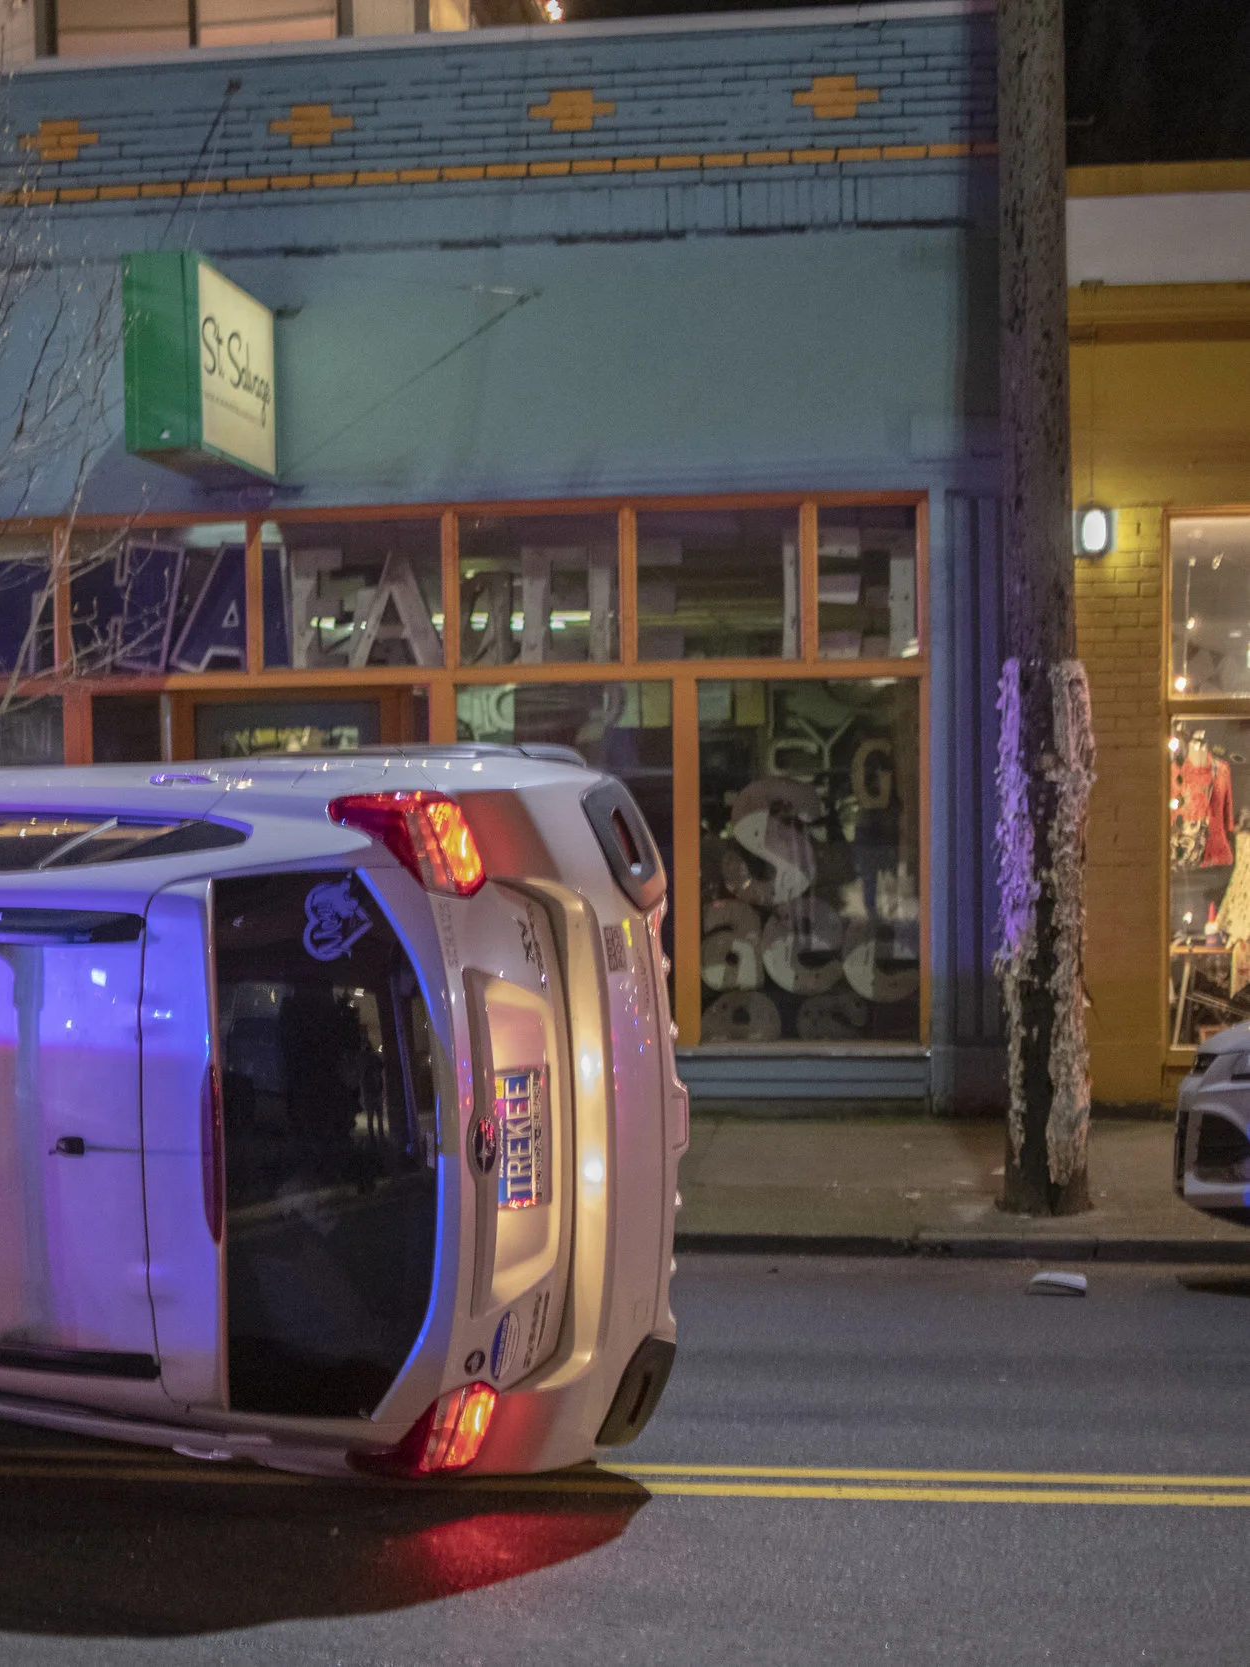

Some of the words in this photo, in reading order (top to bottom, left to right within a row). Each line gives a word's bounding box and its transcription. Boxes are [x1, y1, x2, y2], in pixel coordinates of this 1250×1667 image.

[604, 926, 619, 971] SUB
[614, 929, 626, 968] POP
[506, 1077, 533, 1199] TREKEE
